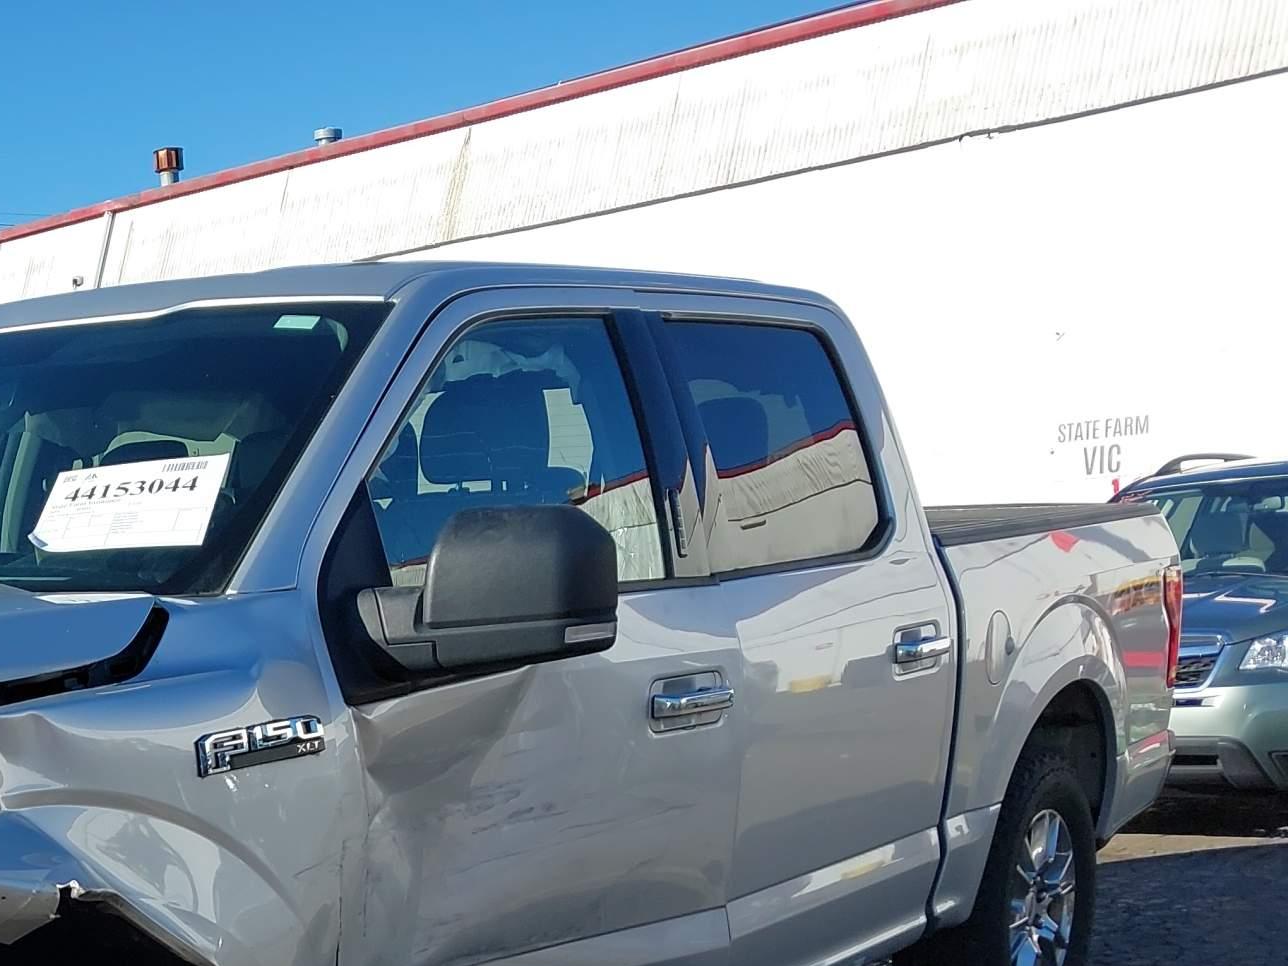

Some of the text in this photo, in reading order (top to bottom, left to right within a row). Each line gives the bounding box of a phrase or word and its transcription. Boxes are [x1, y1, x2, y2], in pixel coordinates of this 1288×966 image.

[1058, 415, 1149, 443] STATE FARM
[1083, 444, 1121, 475] VIC
[64, 475, 199, 502] 44153044
[296, 740, 321, 753] XLT
